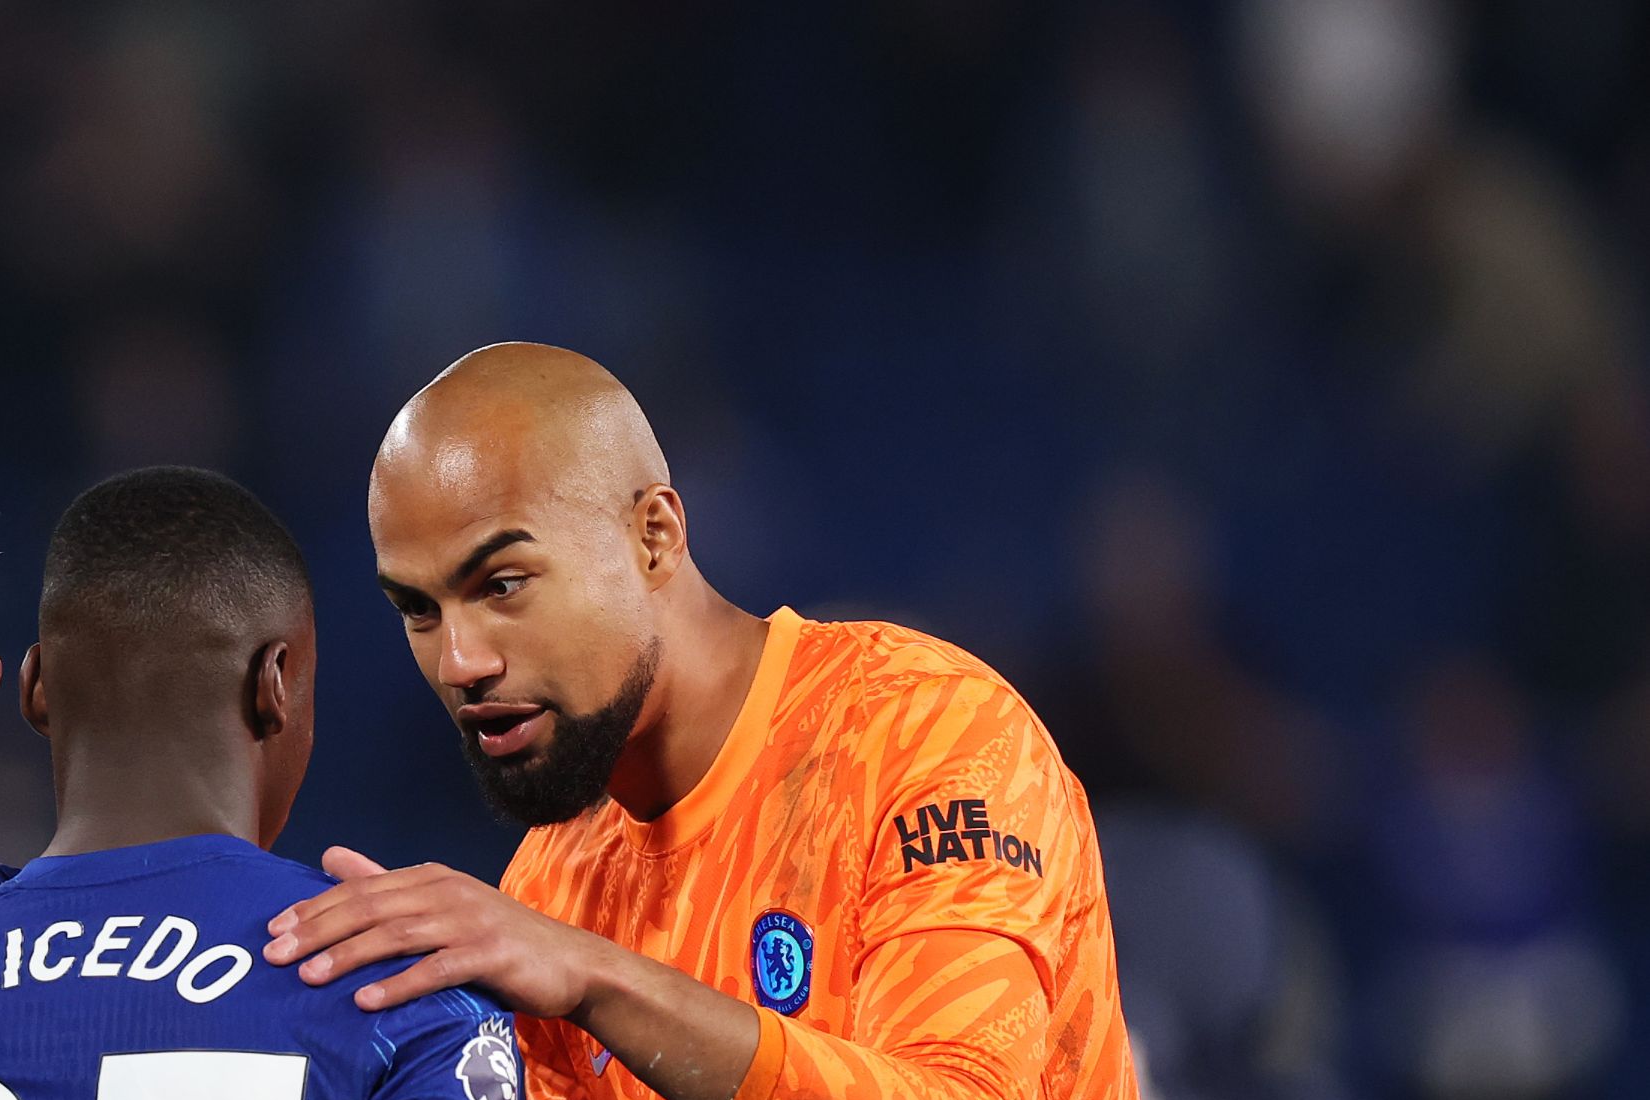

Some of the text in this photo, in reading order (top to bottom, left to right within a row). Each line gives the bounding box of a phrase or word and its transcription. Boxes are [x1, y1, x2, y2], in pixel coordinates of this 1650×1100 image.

[893, 799, 990, 844] LIVE
[901, 829, 1043, 878] NATION
[753, 915, 795, 944] HELSEA
